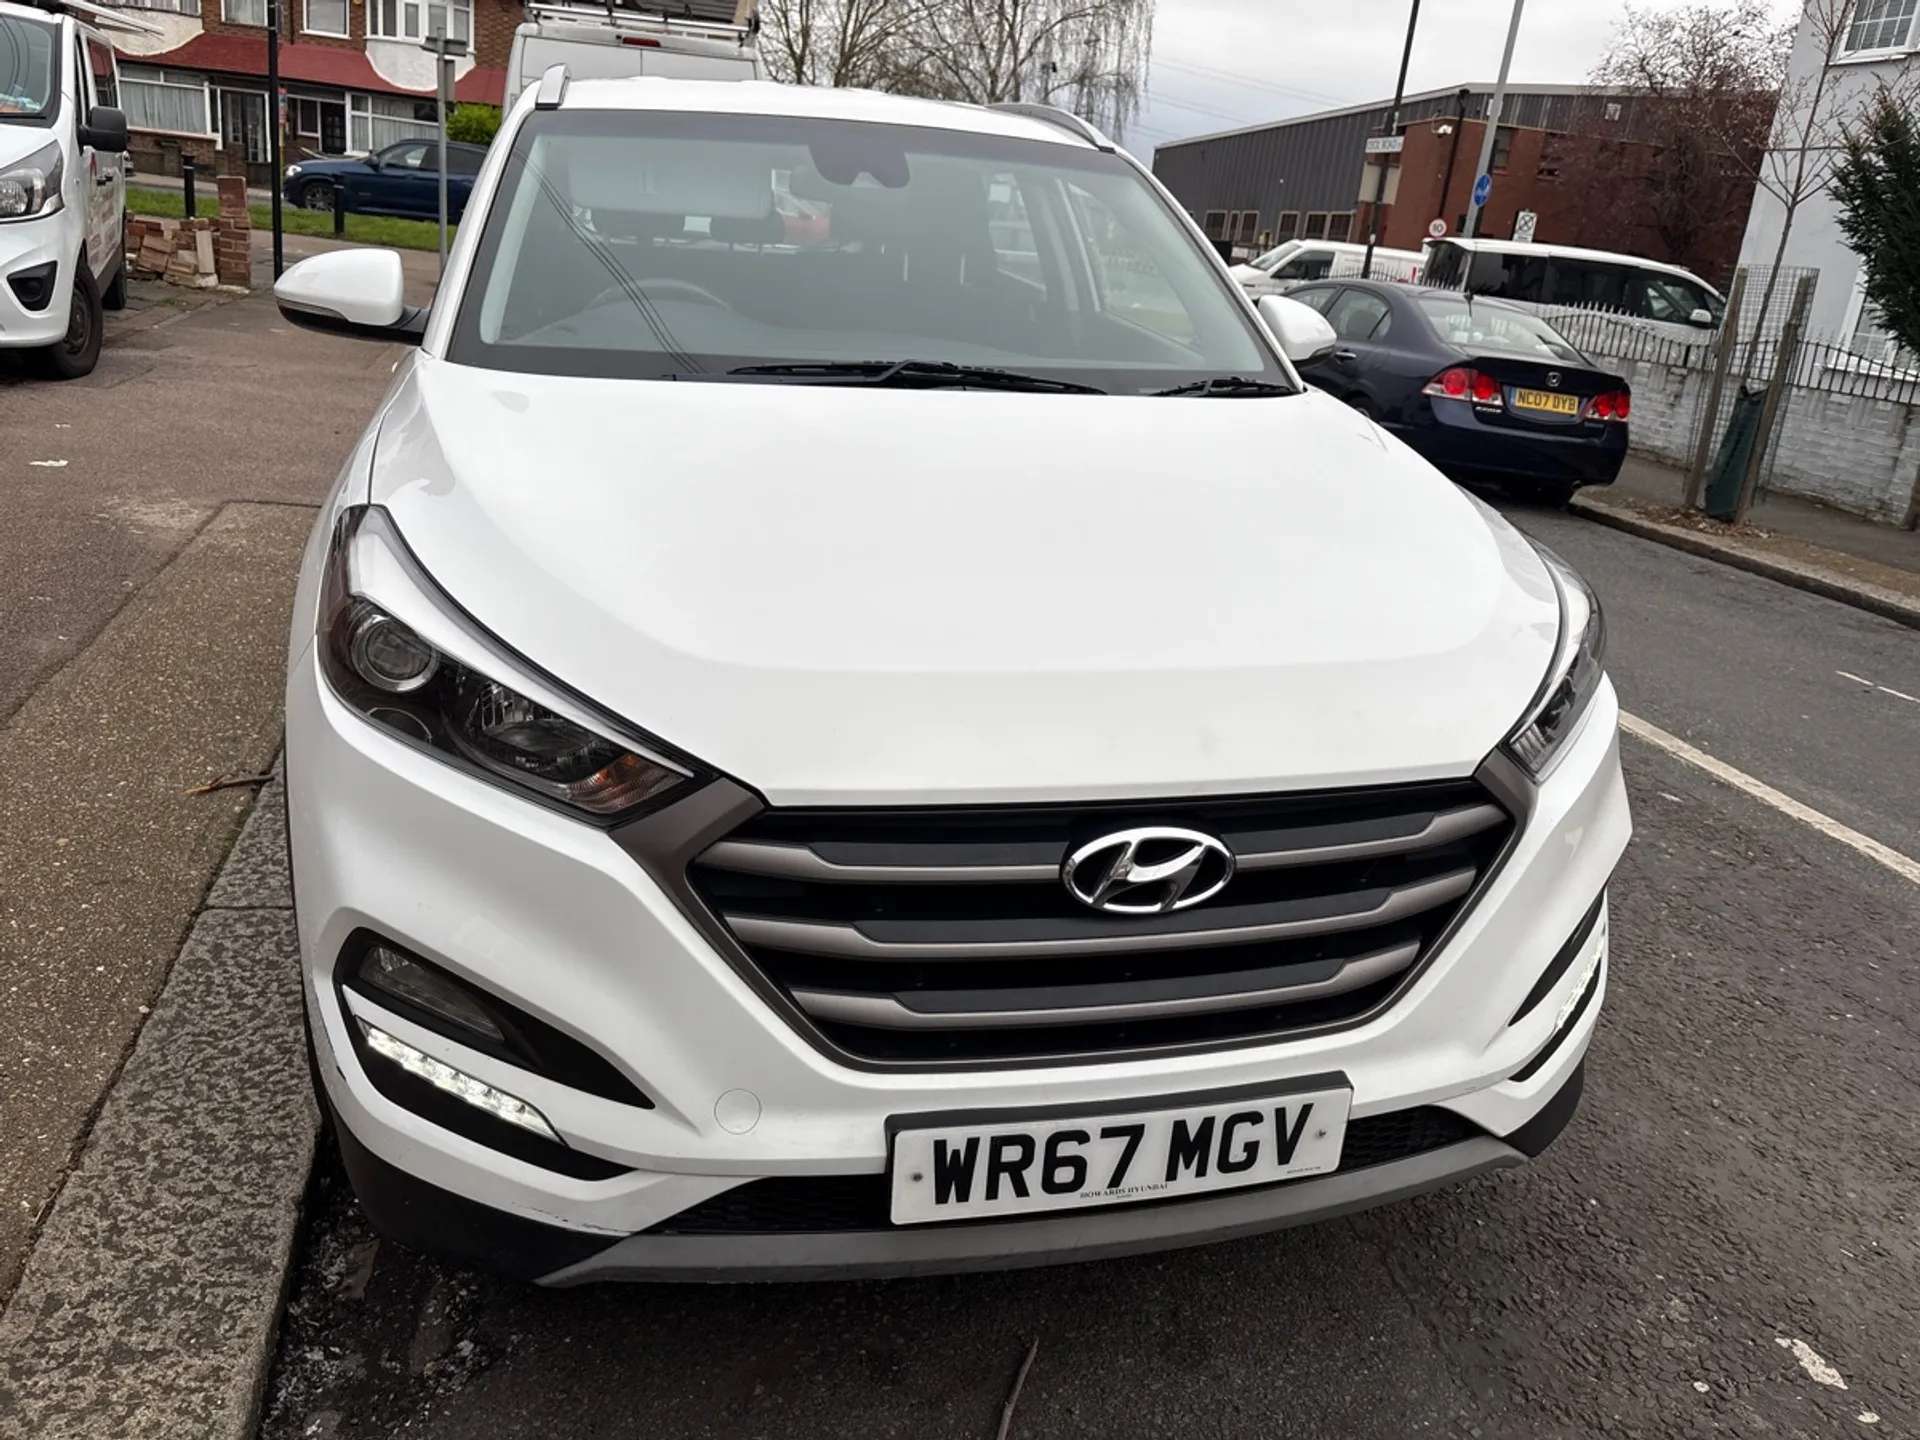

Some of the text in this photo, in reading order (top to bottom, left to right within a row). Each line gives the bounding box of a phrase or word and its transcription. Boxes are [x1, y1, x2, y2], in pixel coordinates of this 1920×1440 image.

[1517, 390, 1576, 411] NC07 DYB
[933, 1103, 1314, 1204] WR67 MGV
[1080, 1183, 1168, 1198] HOWARDS HYUNDAI
